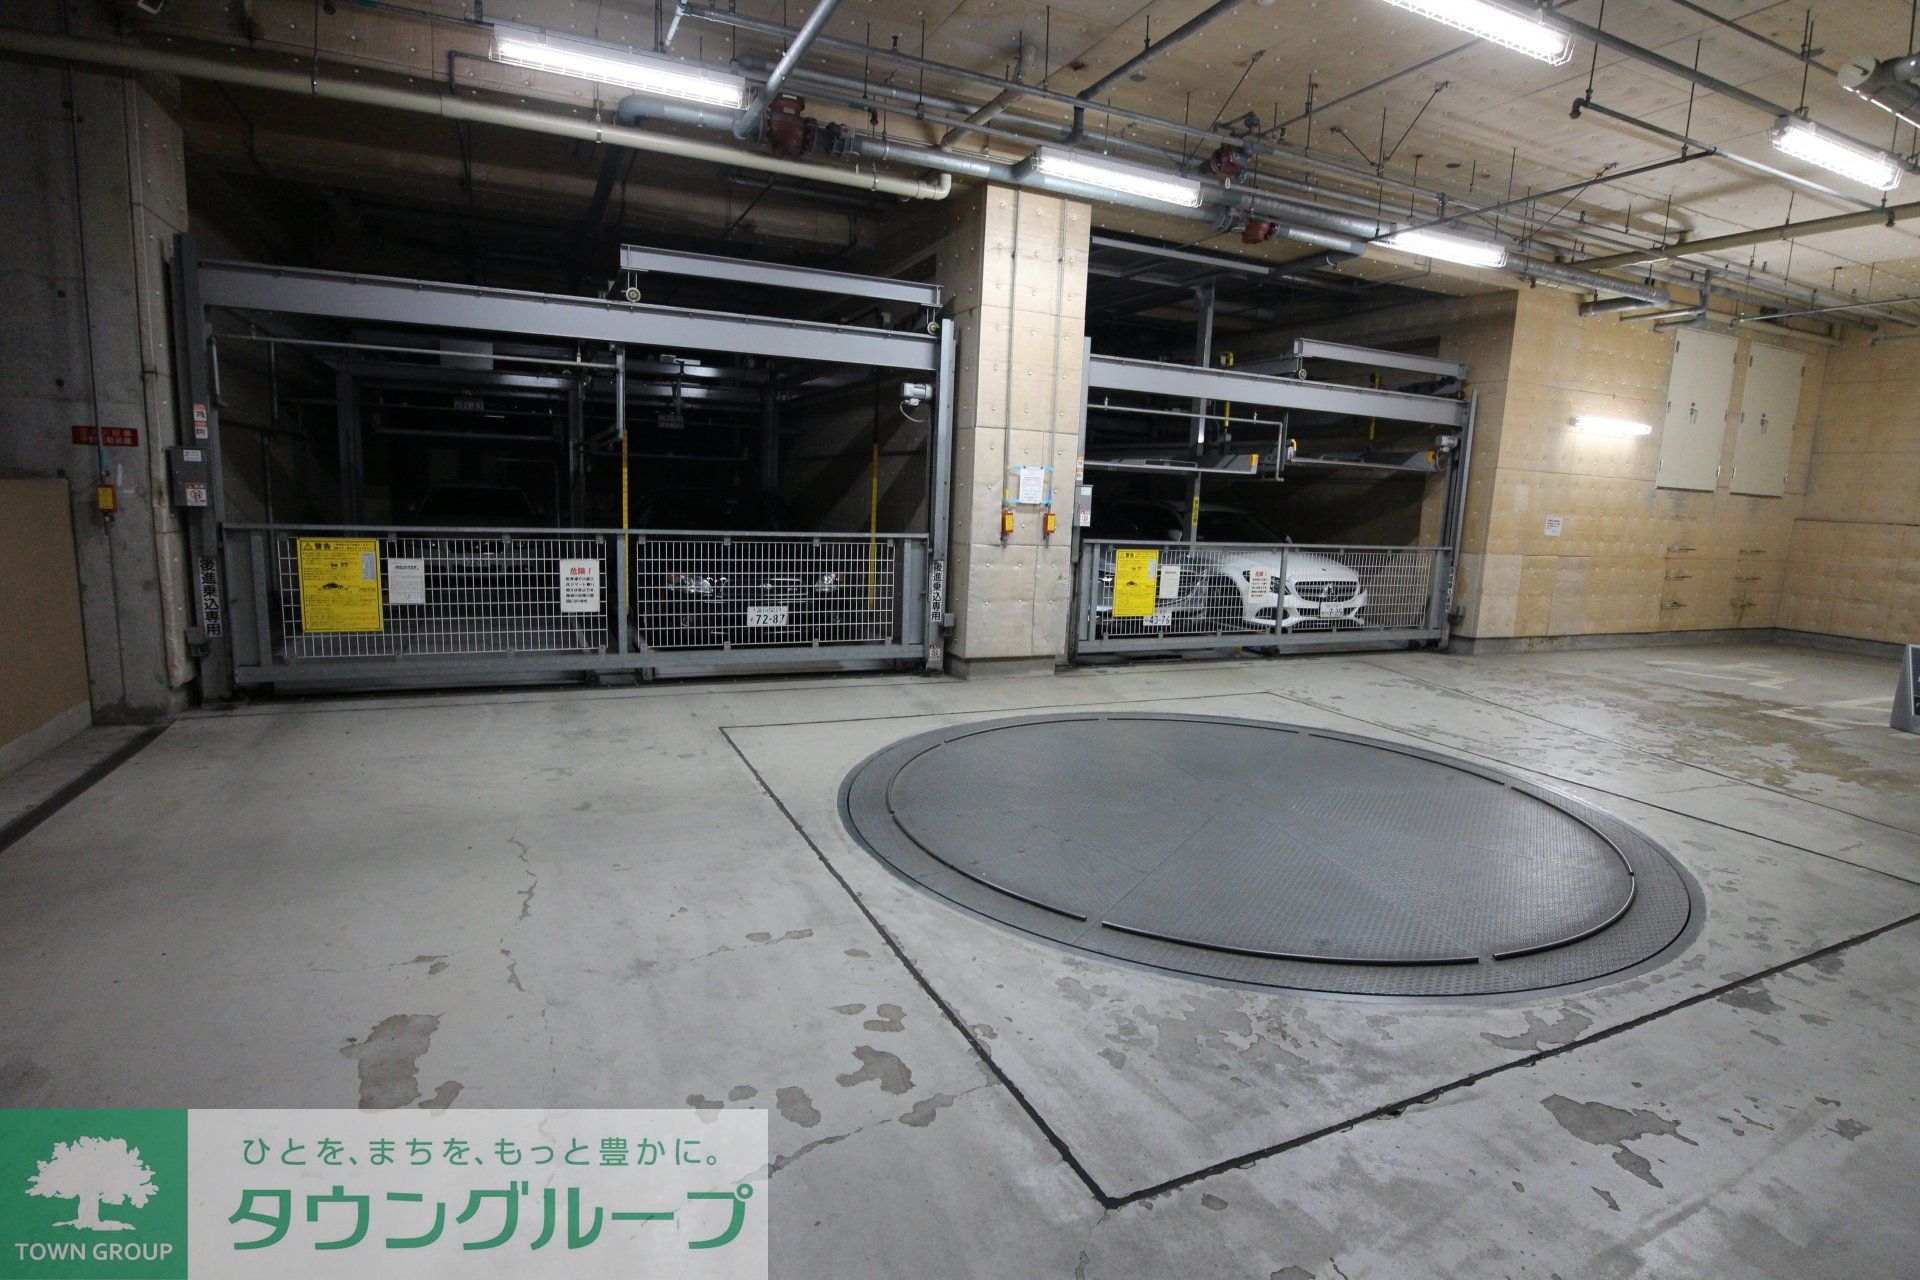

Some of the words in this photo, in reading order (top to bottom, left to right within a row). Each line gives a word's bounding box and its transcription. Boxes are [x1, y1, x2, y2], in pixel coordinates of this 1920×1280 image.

[200, 557, 220, 636] 後進乗込専用
[932, 561, 942, 621] 後進乗込専用
